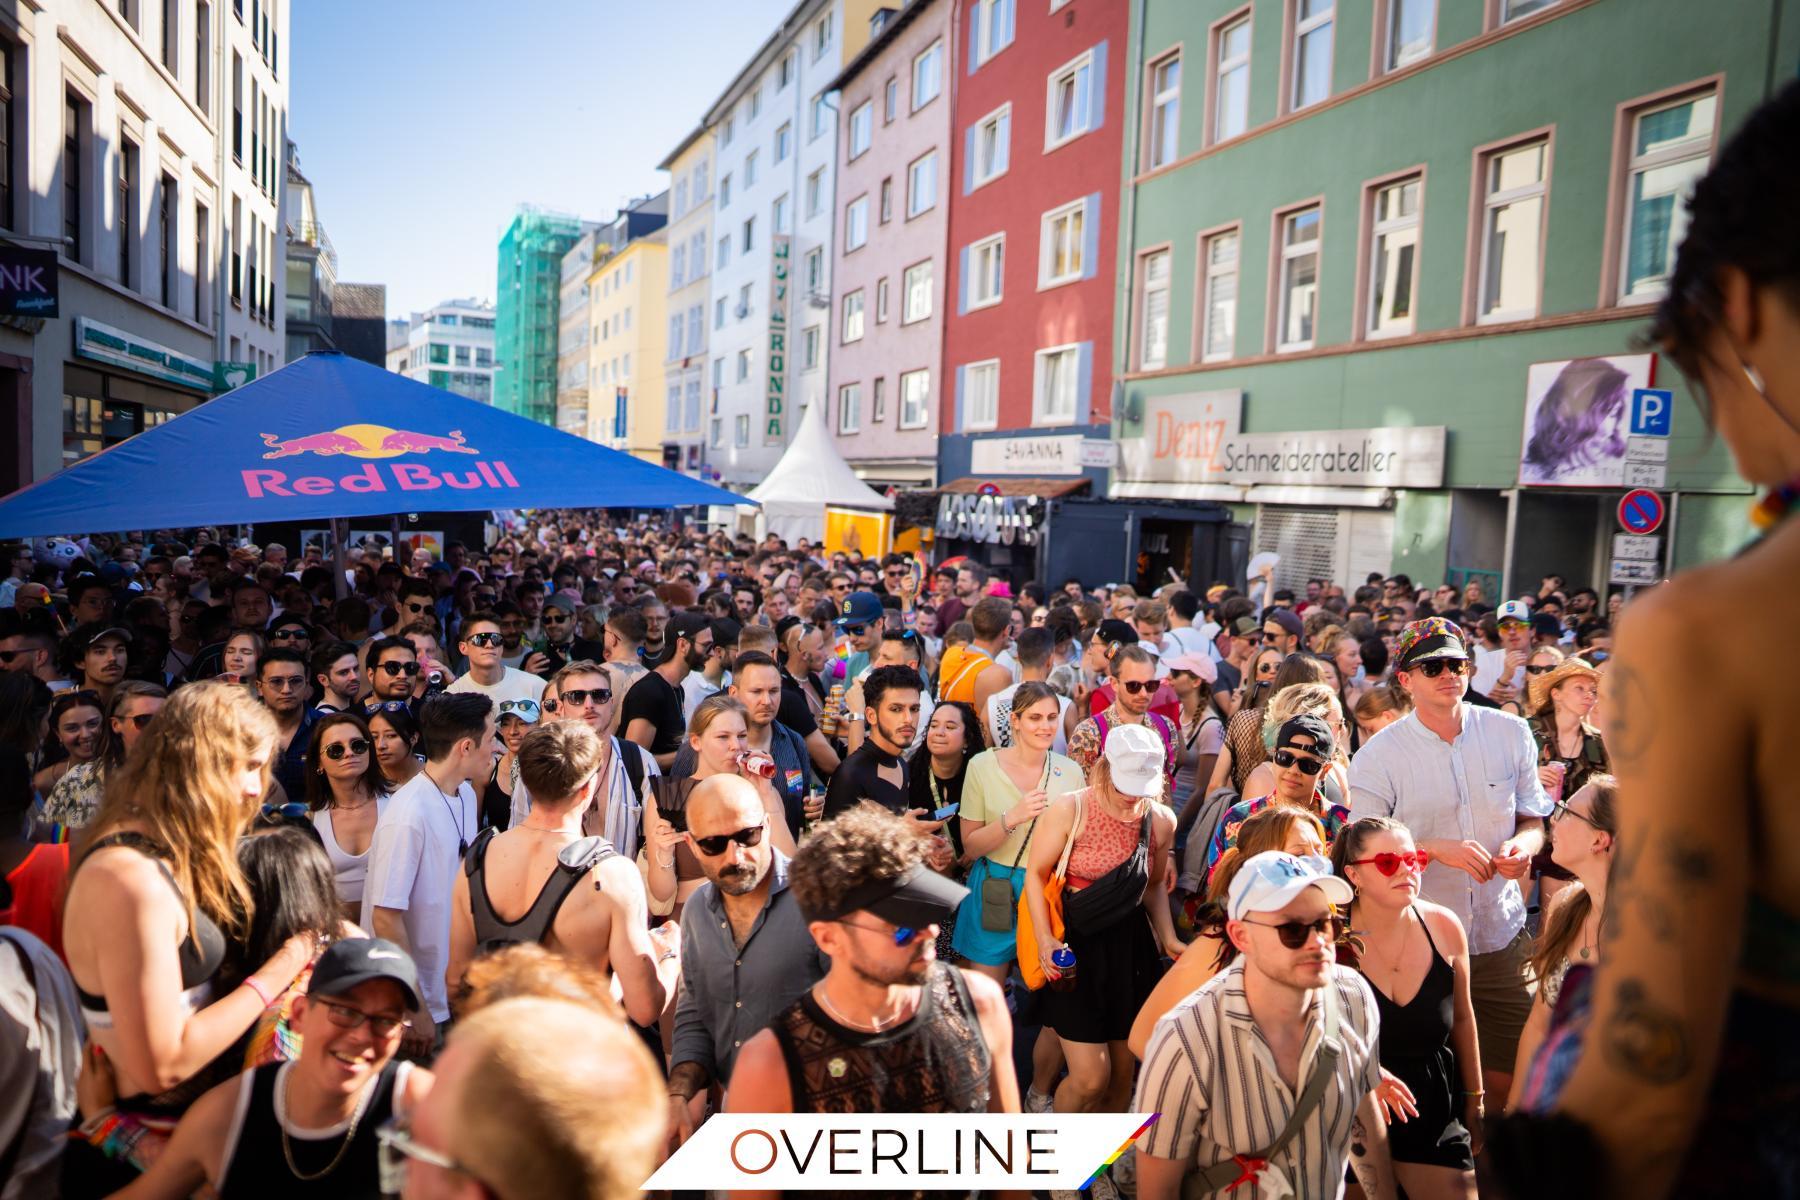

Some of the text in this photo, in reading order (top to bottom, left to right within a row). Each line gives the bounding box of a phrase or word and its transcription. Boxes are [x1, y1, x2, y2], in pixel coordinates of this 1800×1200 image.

[767, 334, 784, 436] RONDA
[1638, 395, 1663, 429] P
[1004, 440, 1064, 461] SAVANNA
[1155, 404, 1226, 473] Deniz
[1223, 439, 1400, 473] Schneideratelier
[241, 461, 521, 498] Red Bull
